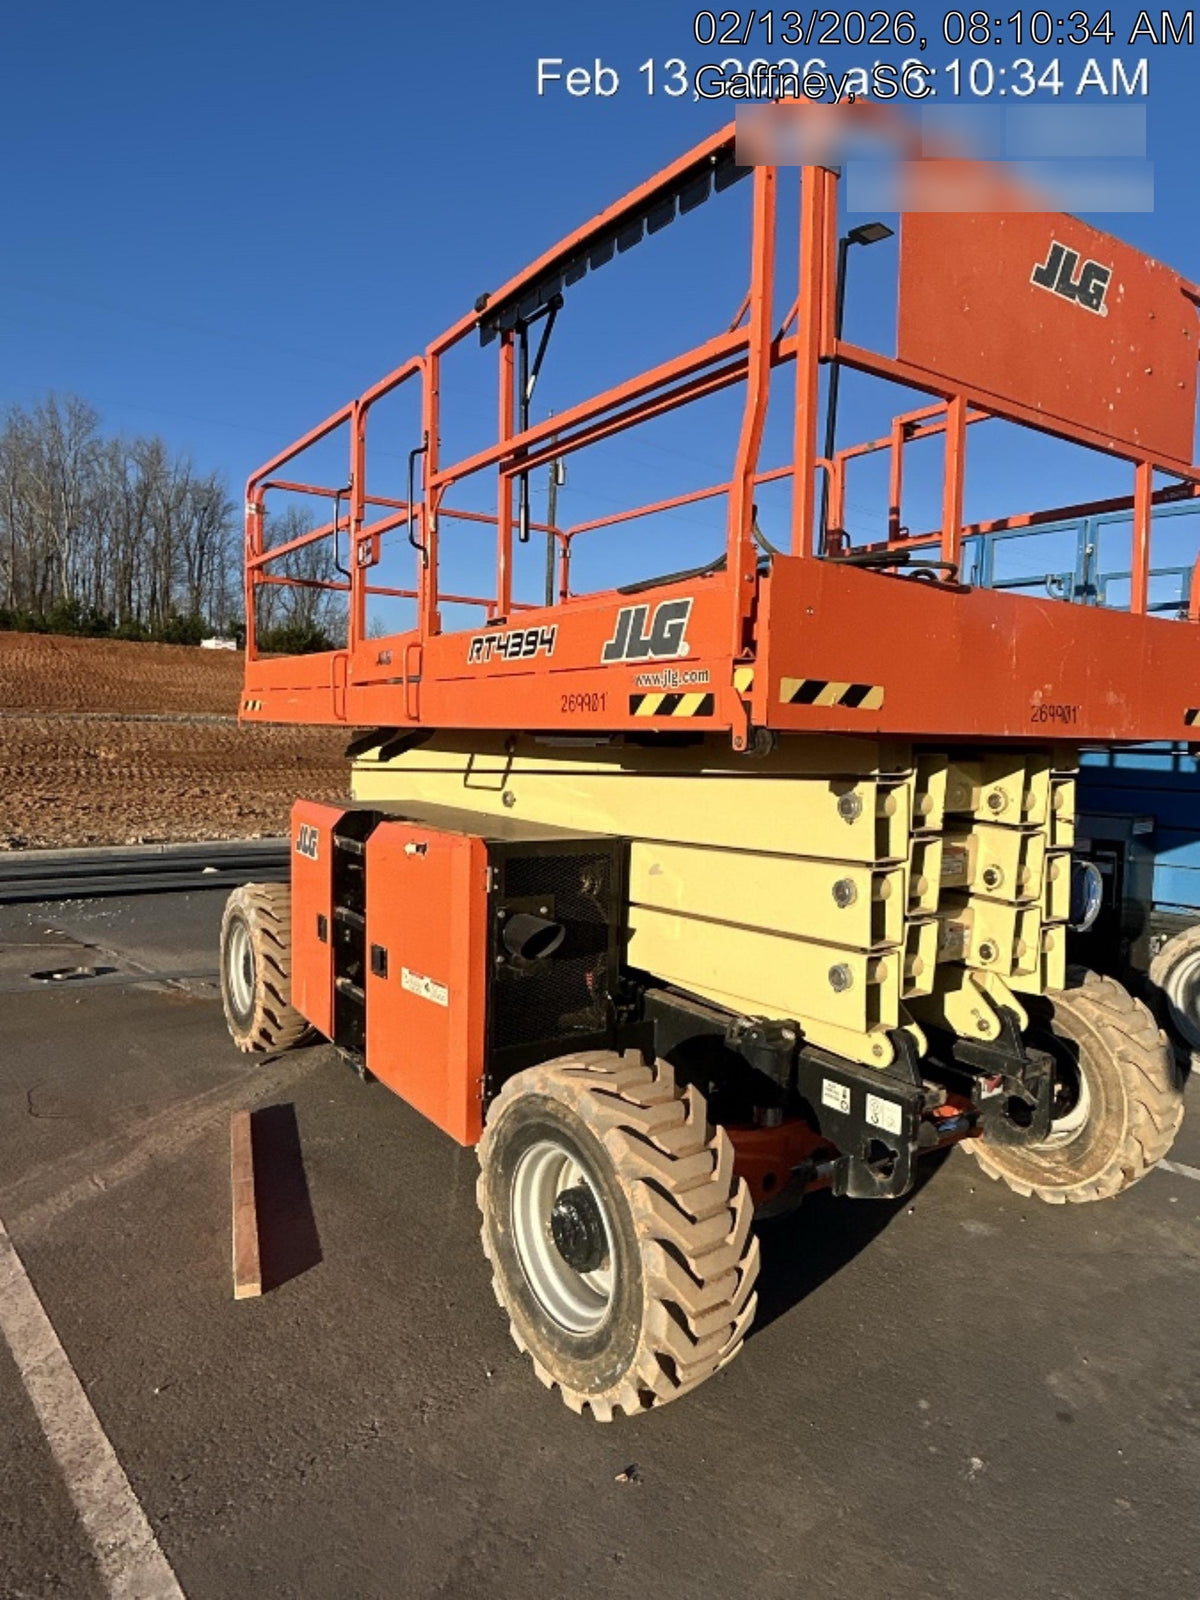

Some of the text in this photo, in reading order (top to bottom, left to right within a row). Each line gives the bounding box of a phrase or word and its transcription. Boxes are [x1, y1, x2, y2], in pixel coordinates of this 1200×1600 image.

[1030, 240, 1112, 317] JLG
[467, 624, 558, 664] RT4394
[600, 597, 694, 664] JLG
[295, 823, 319, 860] JLG
